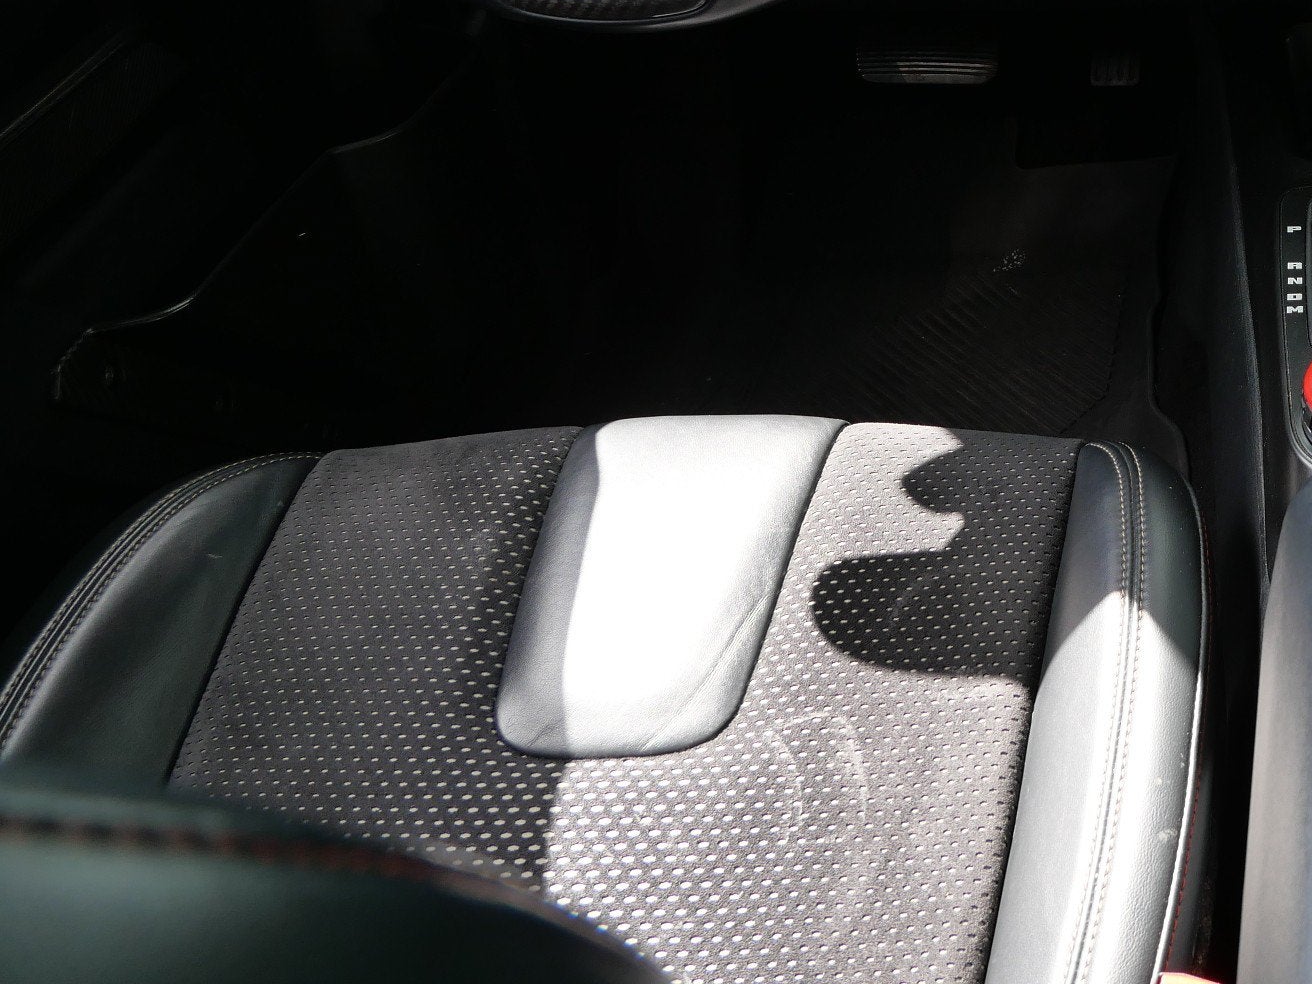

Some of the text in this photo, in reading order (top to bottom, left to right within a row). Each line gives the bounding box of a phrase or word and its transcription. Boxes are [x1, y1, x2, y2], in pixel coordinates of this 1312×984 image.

[1286, 225, 1302, 233] P
[1287, 277, 1303, 285] N
[1286, 293, 1303, 301] D
[1286, 305, 1304, 314] M
